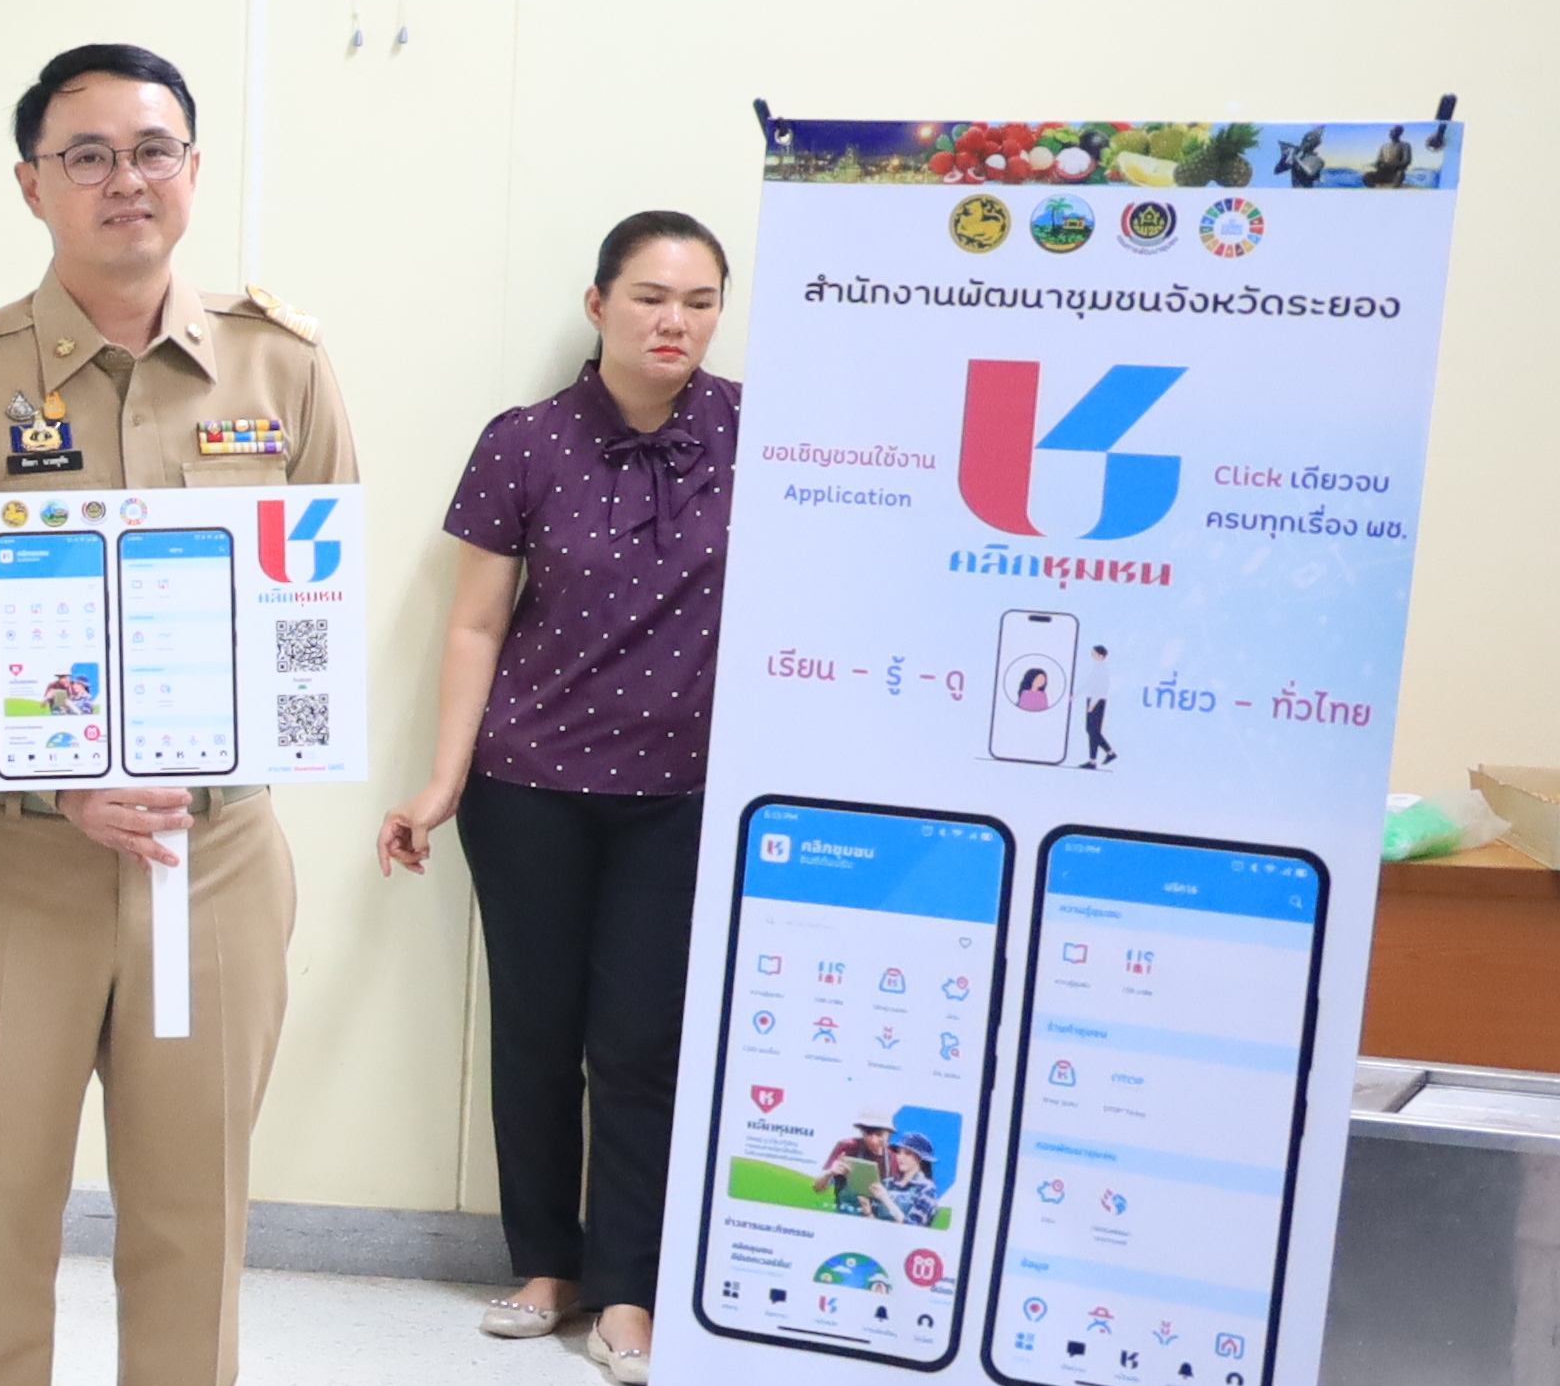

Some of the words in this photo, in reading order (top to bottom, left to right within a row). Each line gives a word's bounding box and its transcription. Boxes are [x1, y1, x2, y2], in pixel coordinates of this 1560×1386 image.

[803, 273, 1402, 322] สำนักงานพัฒนาชุมชนจังหวัดระยอง
[762, 441, 938, 475] ขอเชิญชวนใช้งาน
[1213, 463, 1284, 491] Click
[1290, 462, 1391, 495] เดียวจบ
[783, 482, 913, 510] Application
[1205, 505, 1359, 541] ครบทุกเรื่อง
[948, 543, 1172, 591] คลิกชุมชน
[766, 647, 837, 682] เรียน
[945, 667, 966, 702] ดู
[1141, 669, 1217, 715] เที่ยว
[1271, 682, 1372, 729] ทั่วไทย
